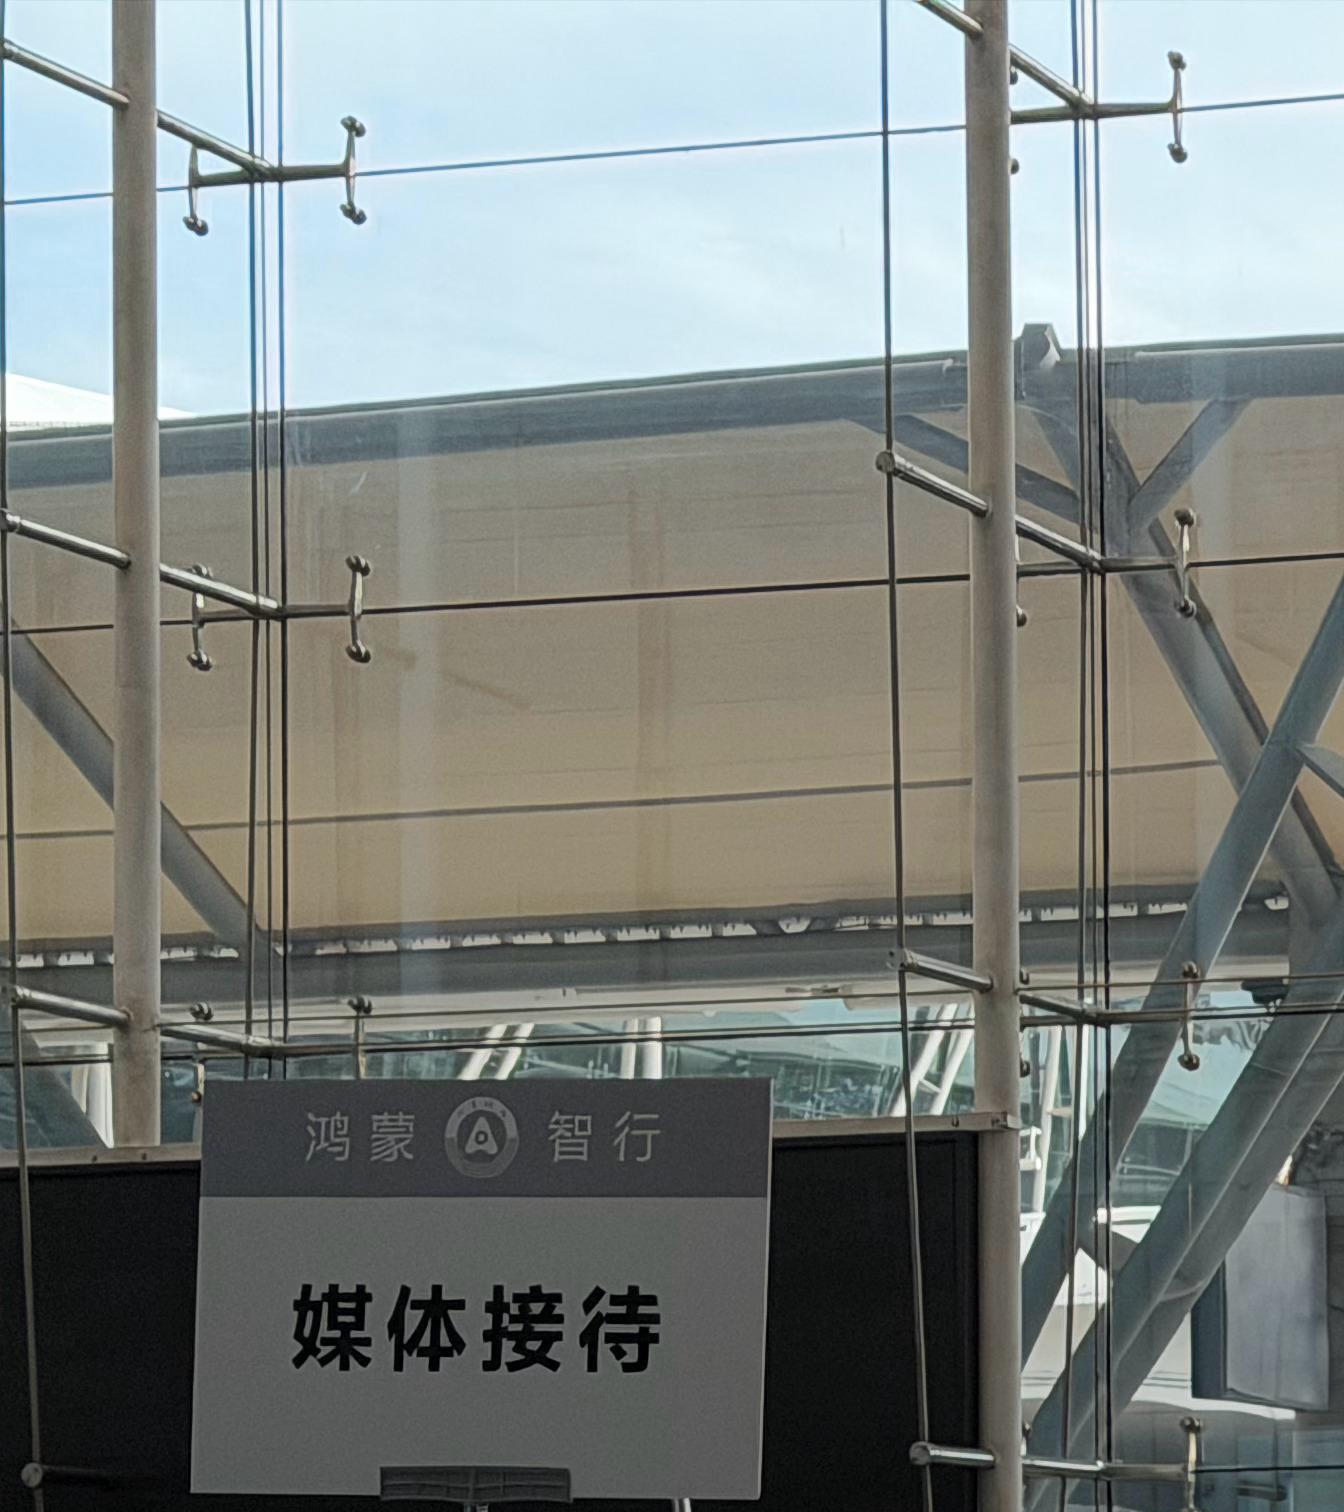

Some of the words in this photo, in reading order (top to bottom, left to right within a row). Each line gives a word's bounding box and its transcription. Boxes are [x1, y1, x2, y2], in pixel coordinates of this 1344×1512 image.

[306, 1112, 415, 1162] 鸿蒙
[548, 1111, 661, 1162] 智行
[292, 1283, 661, 1373] 媒体接待
